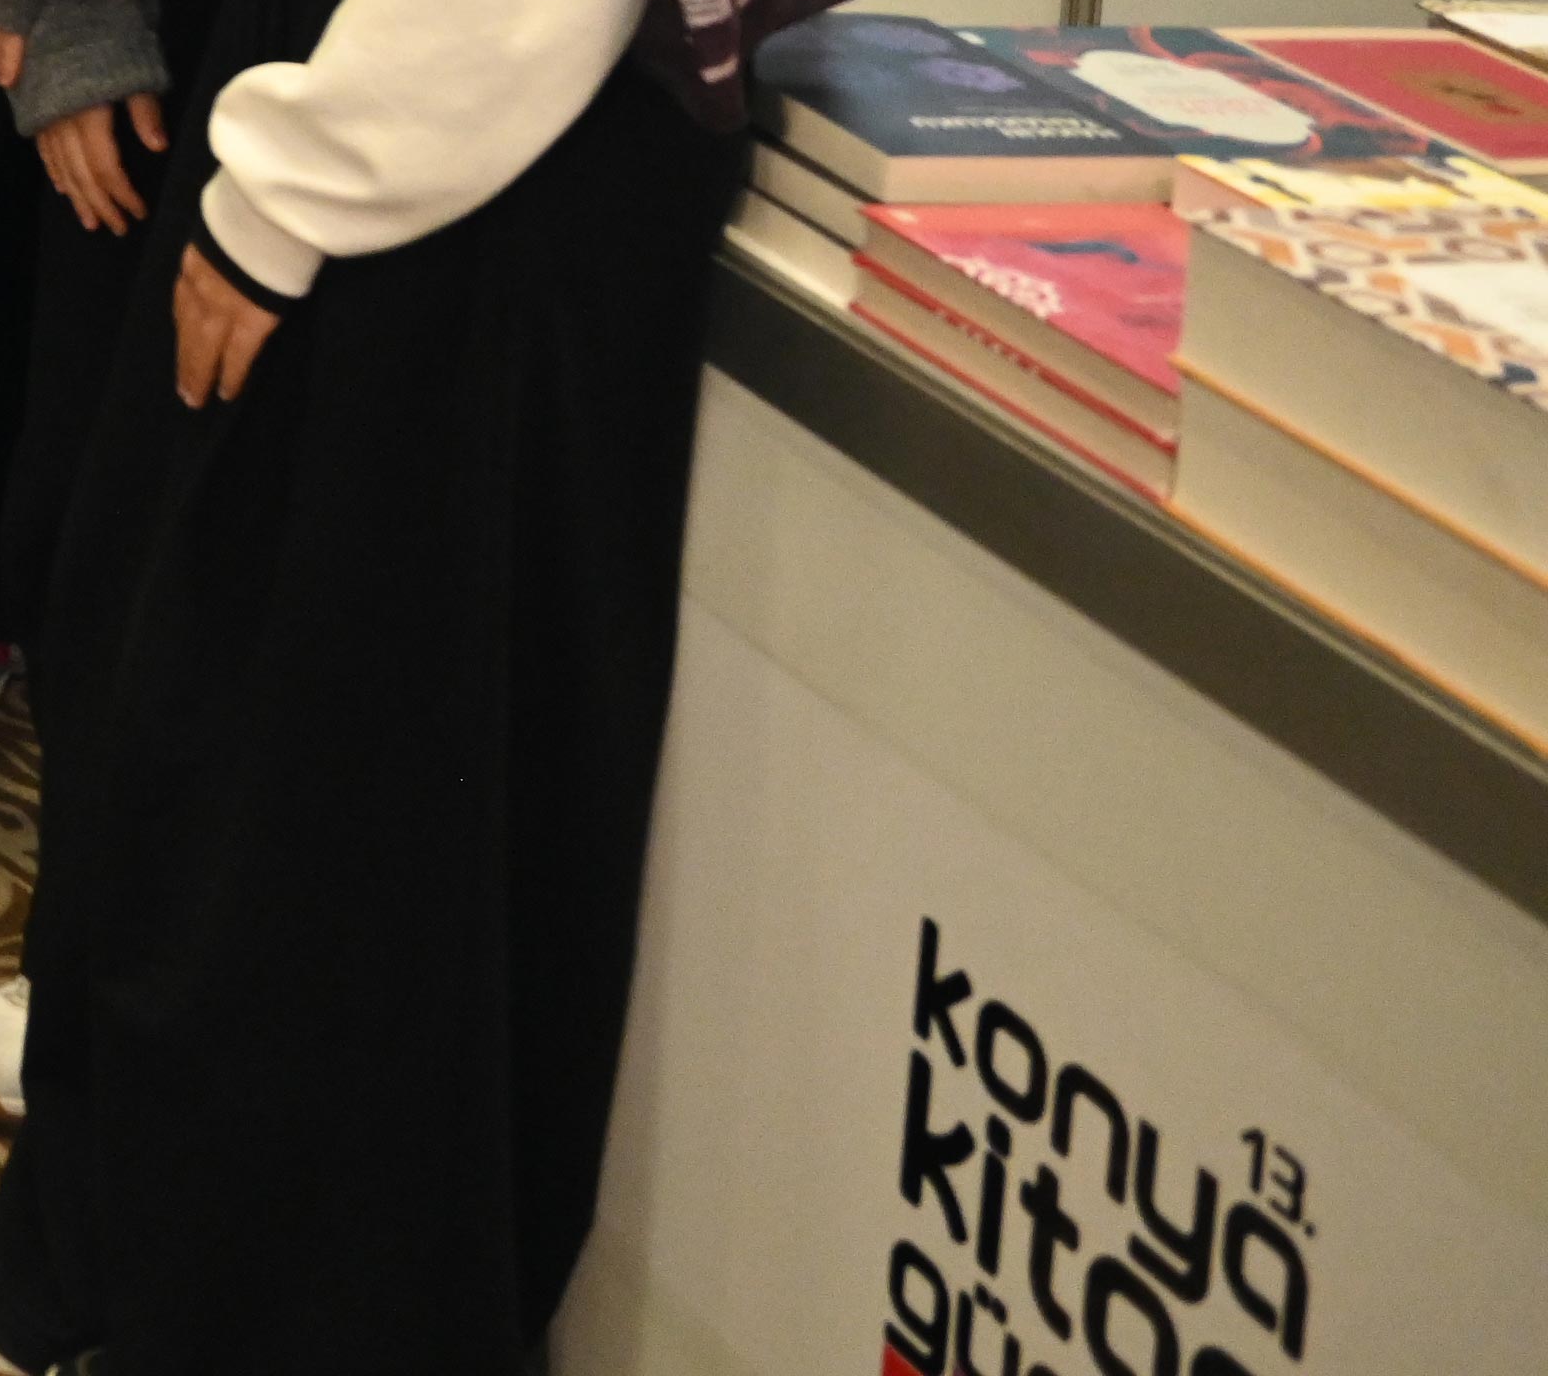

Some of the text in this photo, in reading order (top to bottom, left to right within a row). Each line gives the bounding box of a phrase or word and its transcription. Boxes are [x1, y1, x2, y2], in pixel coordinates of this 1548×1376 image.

[899, 1050, 1257, 1376] kita
[913, 915, 1311, 1362] konya
[1242, 1128, 1316, 1240] 13.
